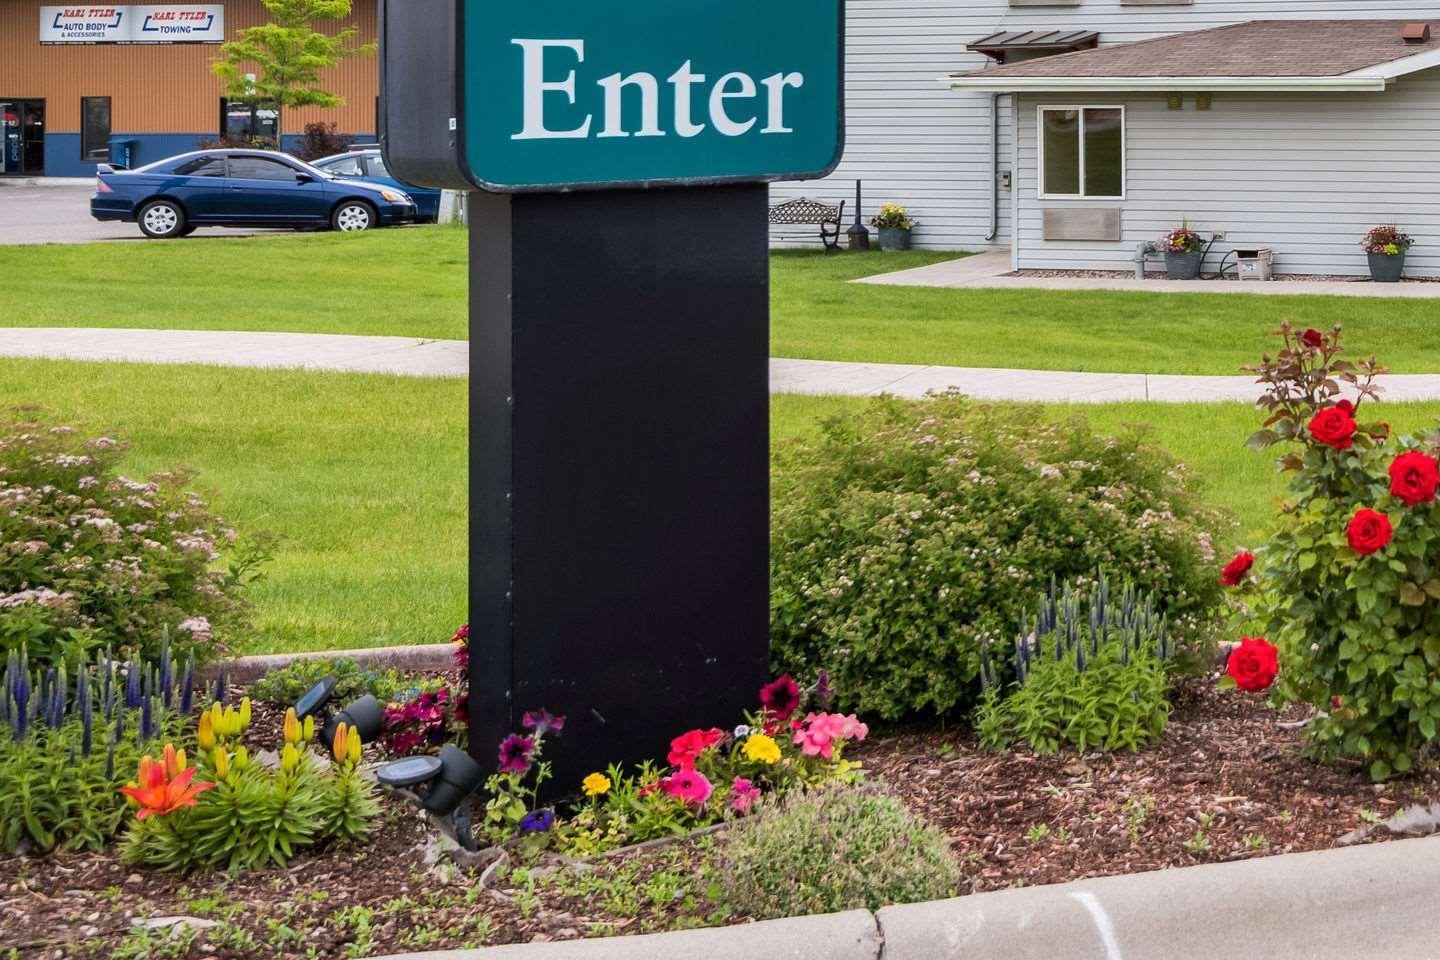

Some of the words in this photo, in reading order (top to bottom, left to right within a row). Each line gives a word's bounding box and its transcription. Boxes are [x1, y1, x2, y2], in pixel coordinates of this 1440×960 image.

[88, 8, 116, 18] TYLER
[179, 11, 207, 20] TYLER
[63, 22, 84, 31] AUTO
[85, 22, 108, 31] BODY
[160, 25, 191, 34] TOWING
[510, 37, 805, 141] Enter
